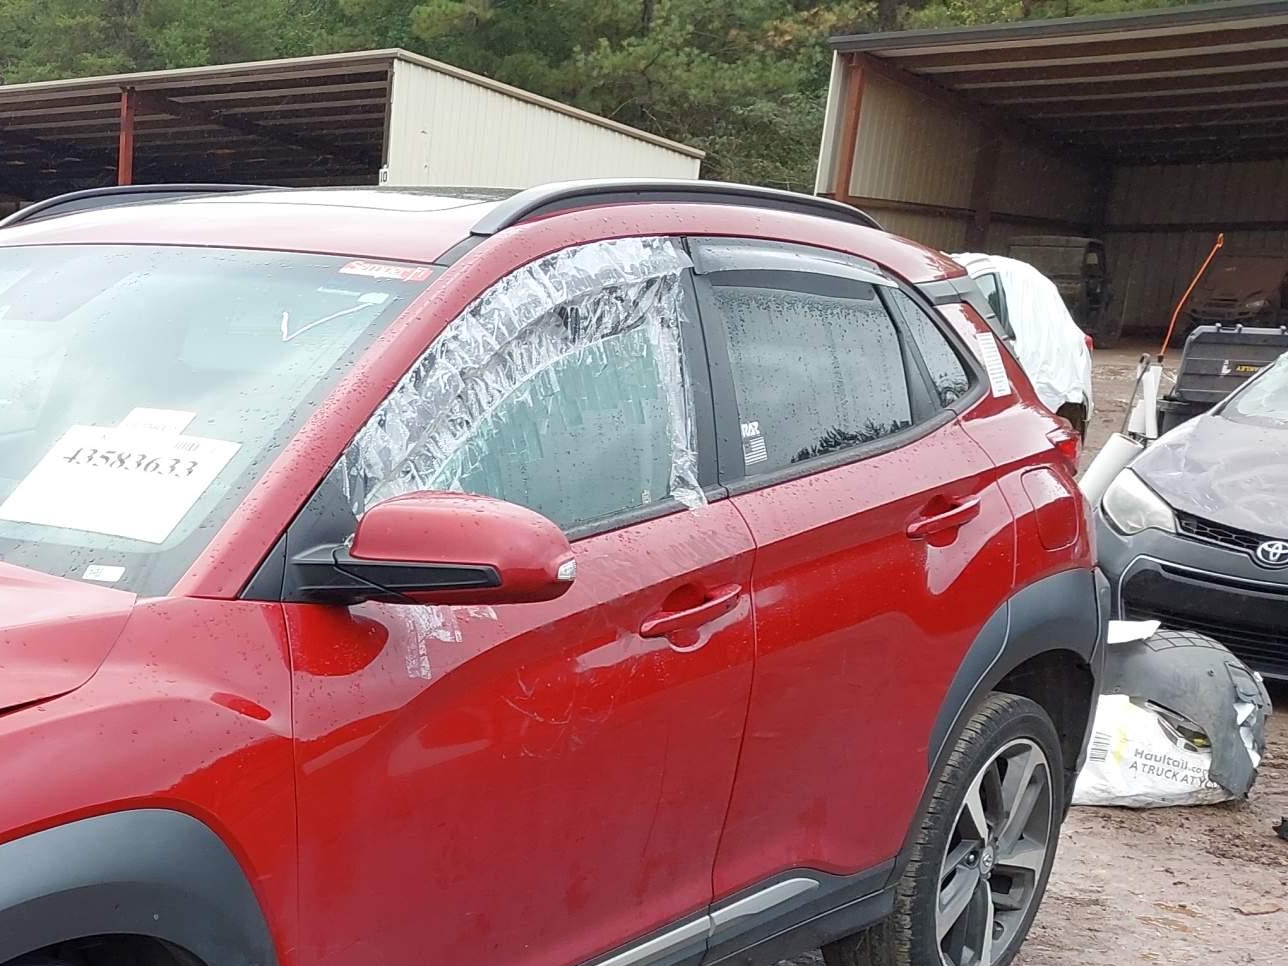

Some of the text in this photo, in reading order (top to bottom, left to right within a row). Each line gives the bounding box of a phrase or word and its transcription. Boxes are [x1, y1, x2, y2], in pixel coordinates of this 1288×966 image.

[63, 447, 199, 477] 43583633
[1129, 761, 1138, 770] A
[1141, 763, 1180, 782] TRUCK
[1180, 774, 1195, 785] AT
